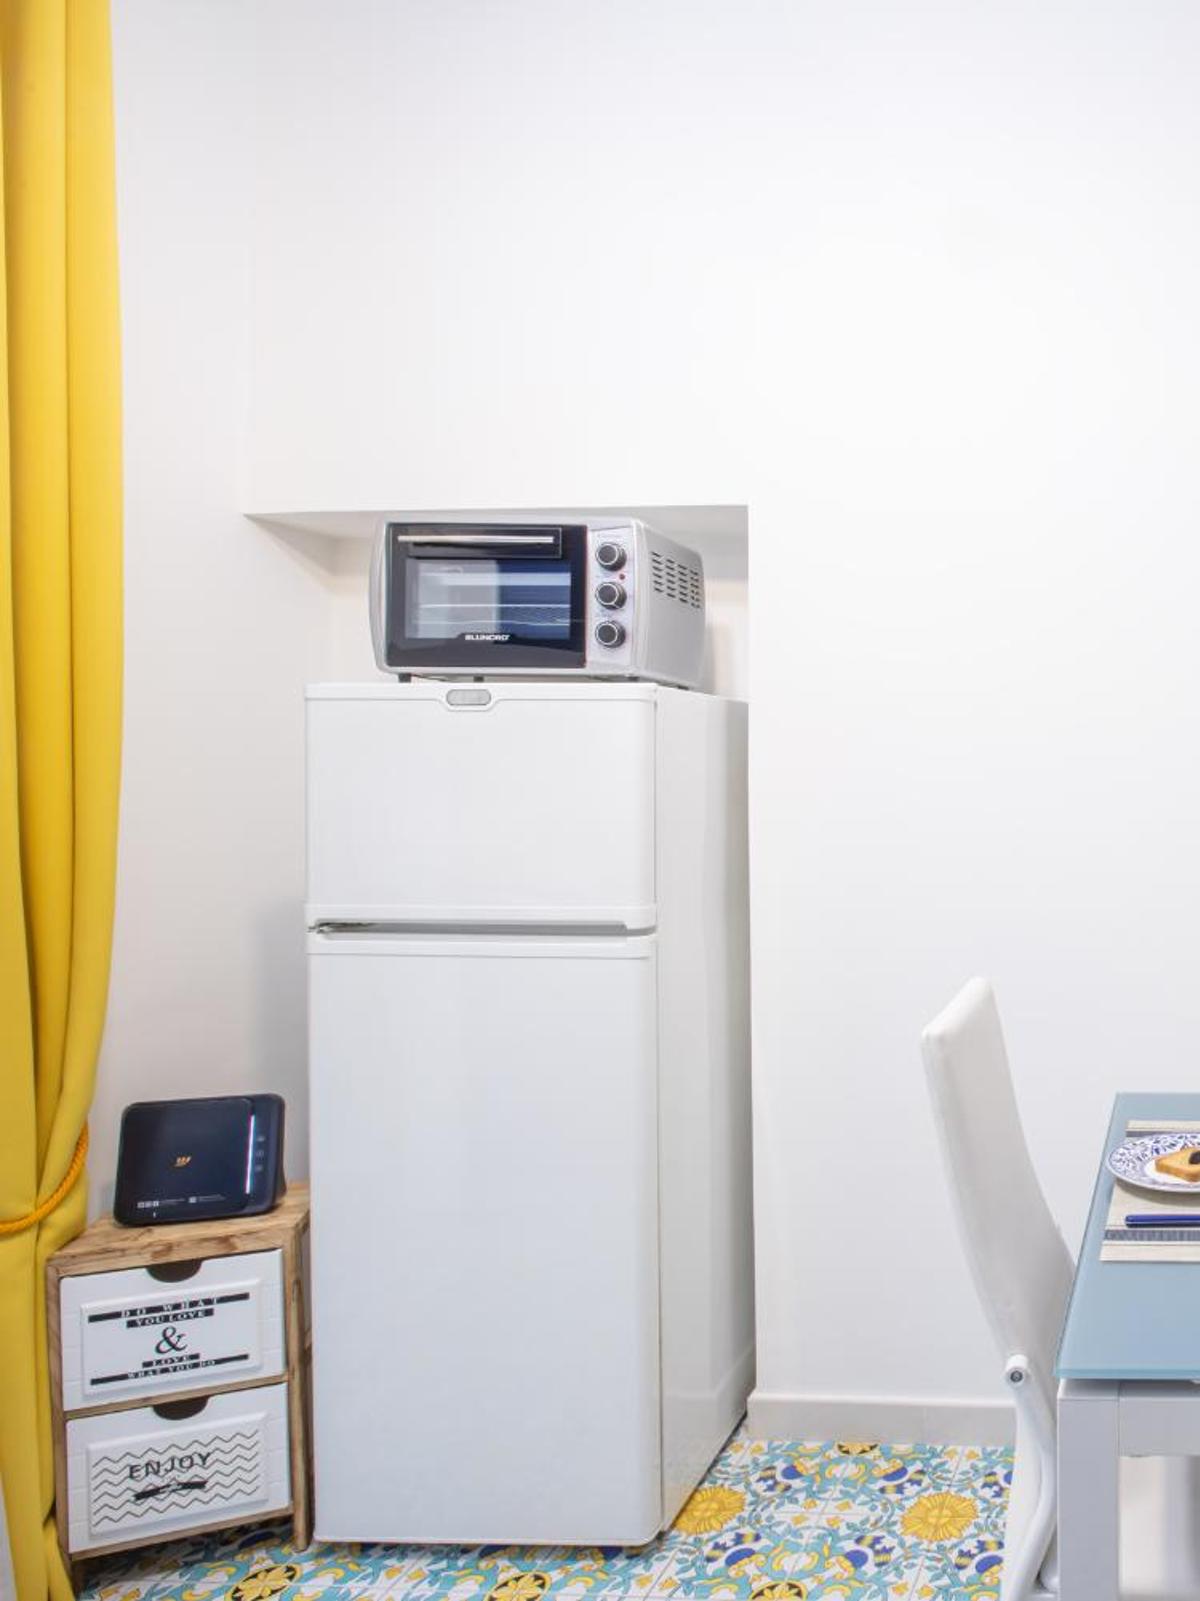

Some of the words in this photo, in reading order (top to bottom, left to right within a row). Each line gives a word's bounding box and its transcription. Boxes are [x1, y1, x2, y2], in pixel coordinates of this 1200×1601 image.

[121, 1308, 147, 1319] DO
[162, 1296, 219, 1313] WHAT
[136, 1315, 164, 1327] YOU
[168, 1309, 206, 1322] LOVE
[154, 1326, 188, 1355] &
[127, 1368, 161, 1379] WHAT
[169, 1362, 194, 1373] YOU
[152, 1355, 190, 1367] LOVE
[129, 1452, 212, 1479] ENJOY
